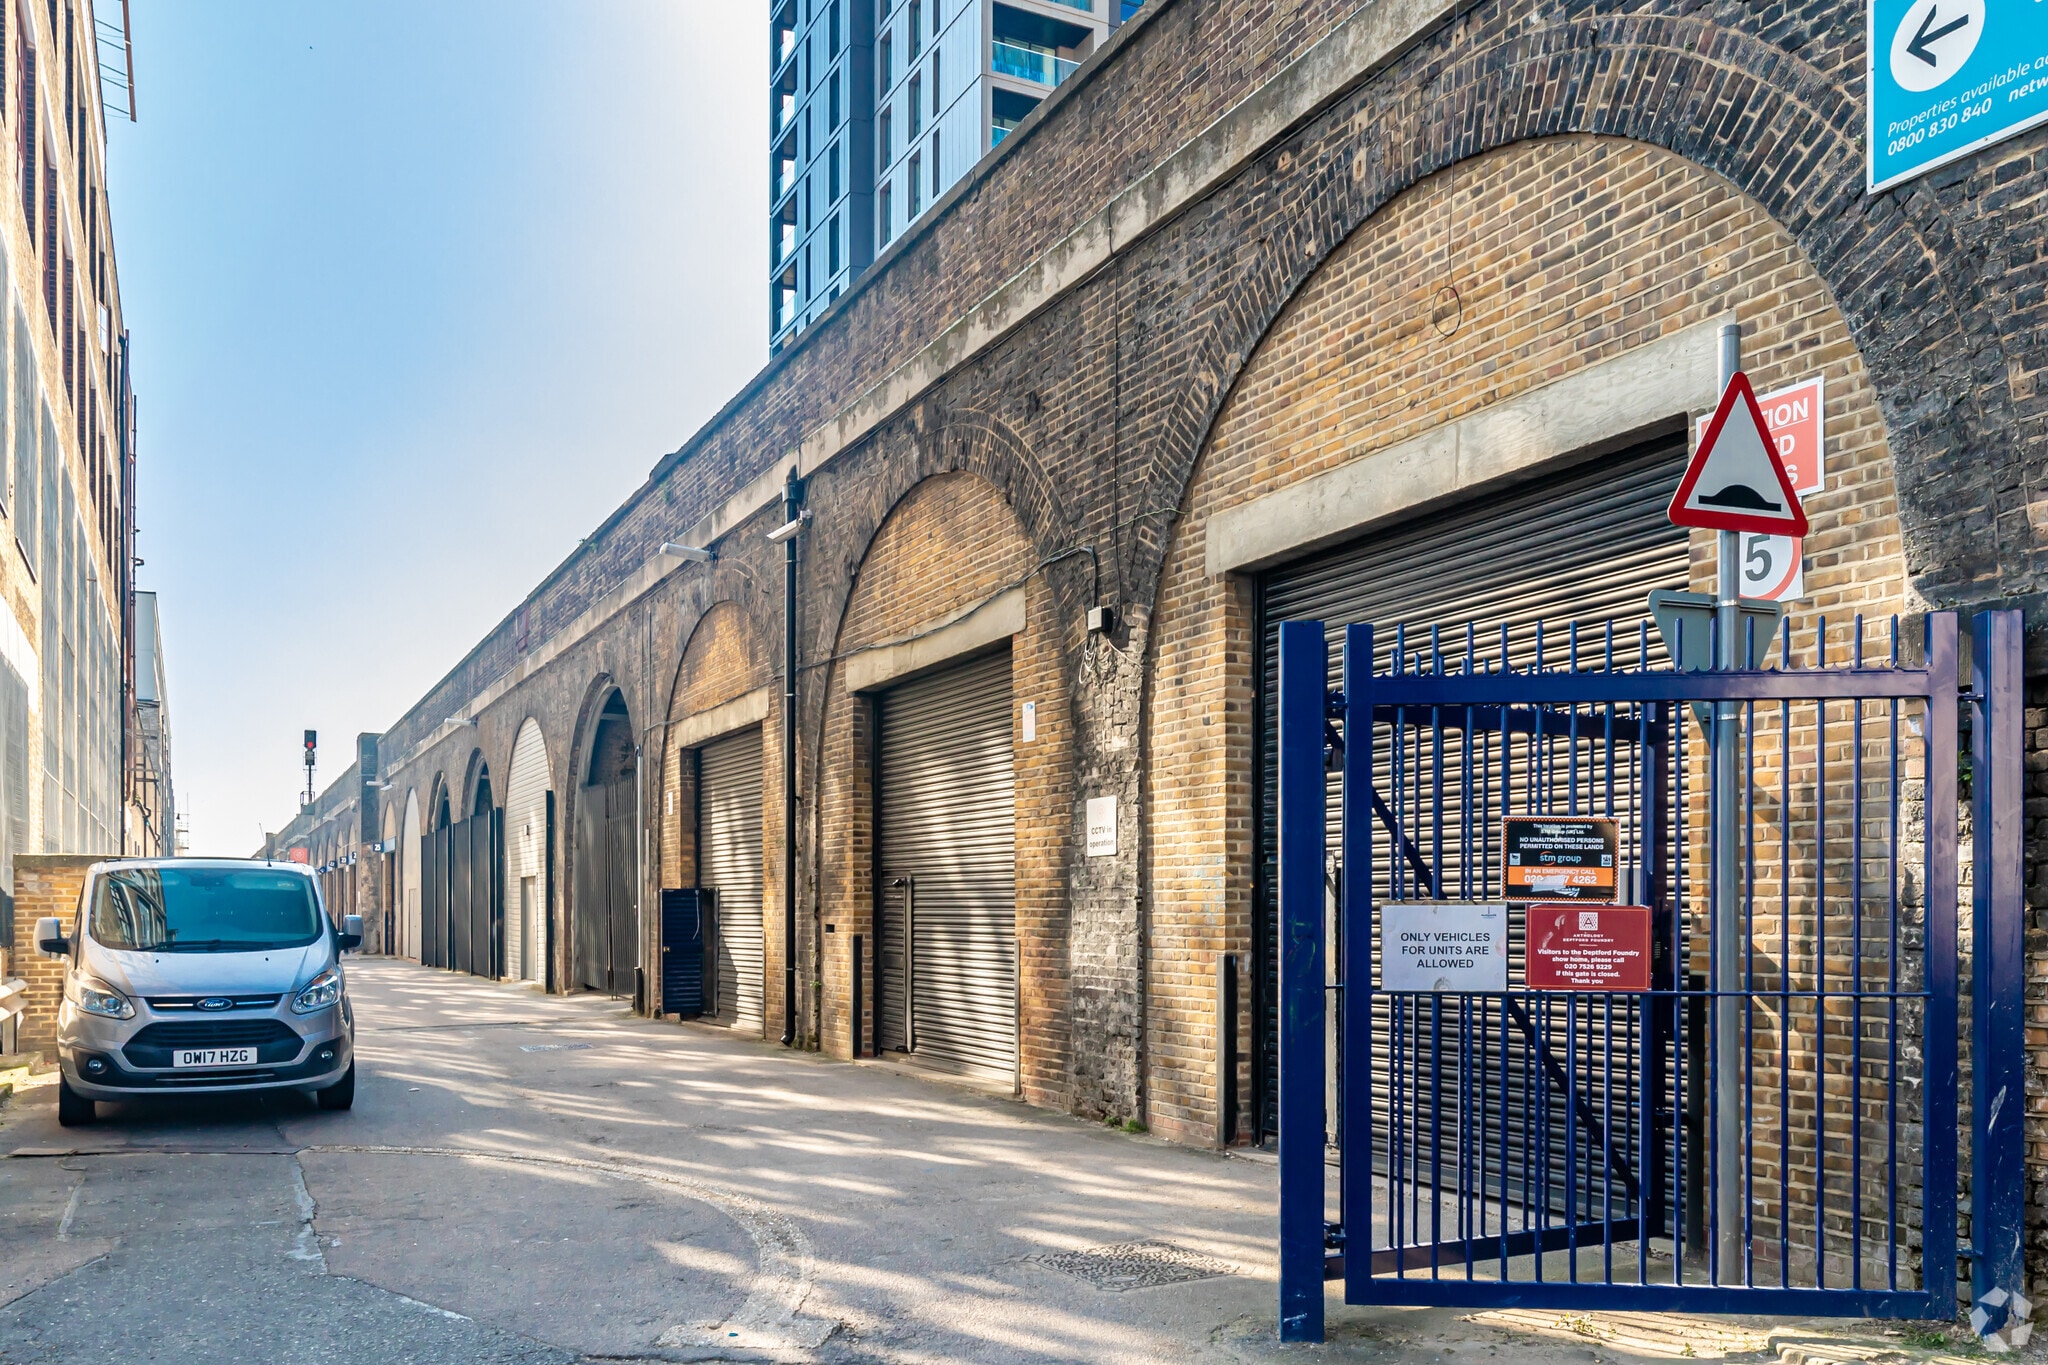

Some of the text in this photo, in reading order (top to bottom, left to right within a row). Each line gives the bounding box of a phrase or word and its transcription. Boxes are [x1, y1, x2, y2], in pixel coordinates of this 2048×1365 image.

[1887, 95, 1957, 138] Properties
[1961, 62, 2030, 104] available
[1887, 128, 1925, 157] 0800
[1928, 113, 1958, 138] 830
[1961, 97, 1993, 123] 840
[1091, 826, 1106, 835] CCTV
[1089, 840, 1114, 849] operation
[1540, 854, 1582, 864] stm group
[1572, 876, 1597, 884] 4262
[1400, 932, 1490, 942] ONLY VEHICLES
[1402, 945, 1489, 955] FOR UNITS ARE
[1416, 959, 1474, 969] ALLOWED
[183, 1050, 248, 1065] OW17 HZG
